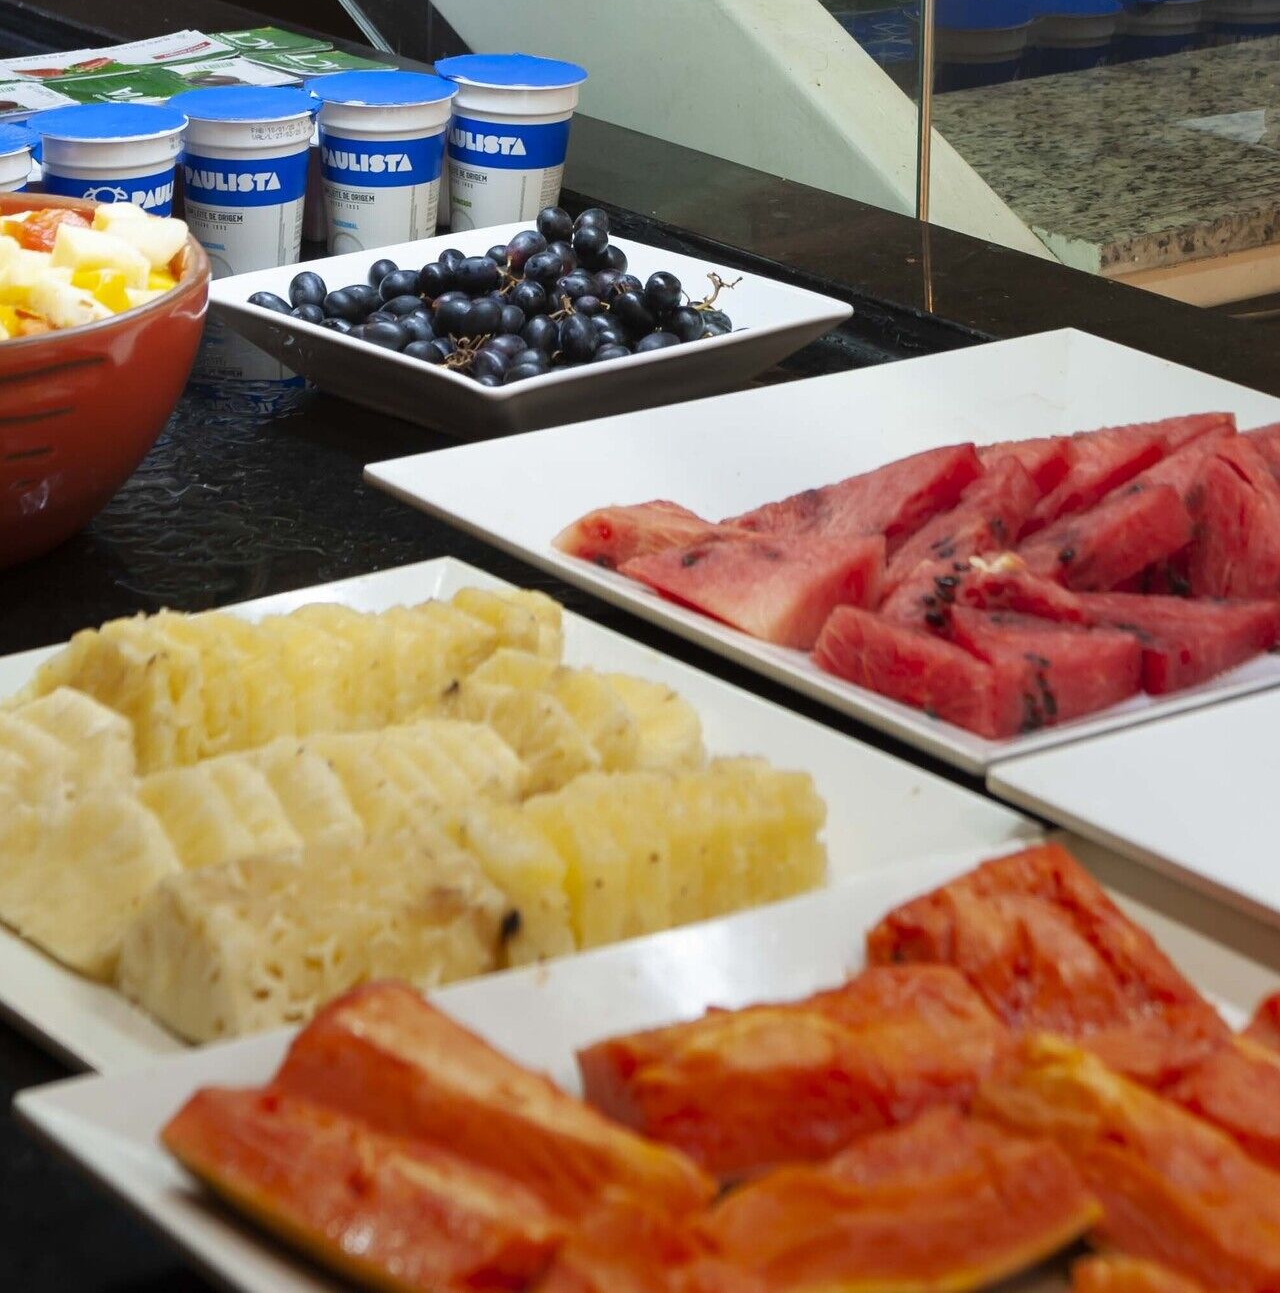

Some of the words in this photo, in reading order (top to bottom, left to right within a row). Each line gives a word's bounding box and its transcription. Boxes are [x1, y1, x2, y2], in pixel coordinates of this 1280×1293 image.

[185, 166, 281, 193] PAULISTA
[351, 193, 375, 203] ORIGEM
[208, 212, 217, 221] DE
[218, 214, 243, 223] ORIGEM
